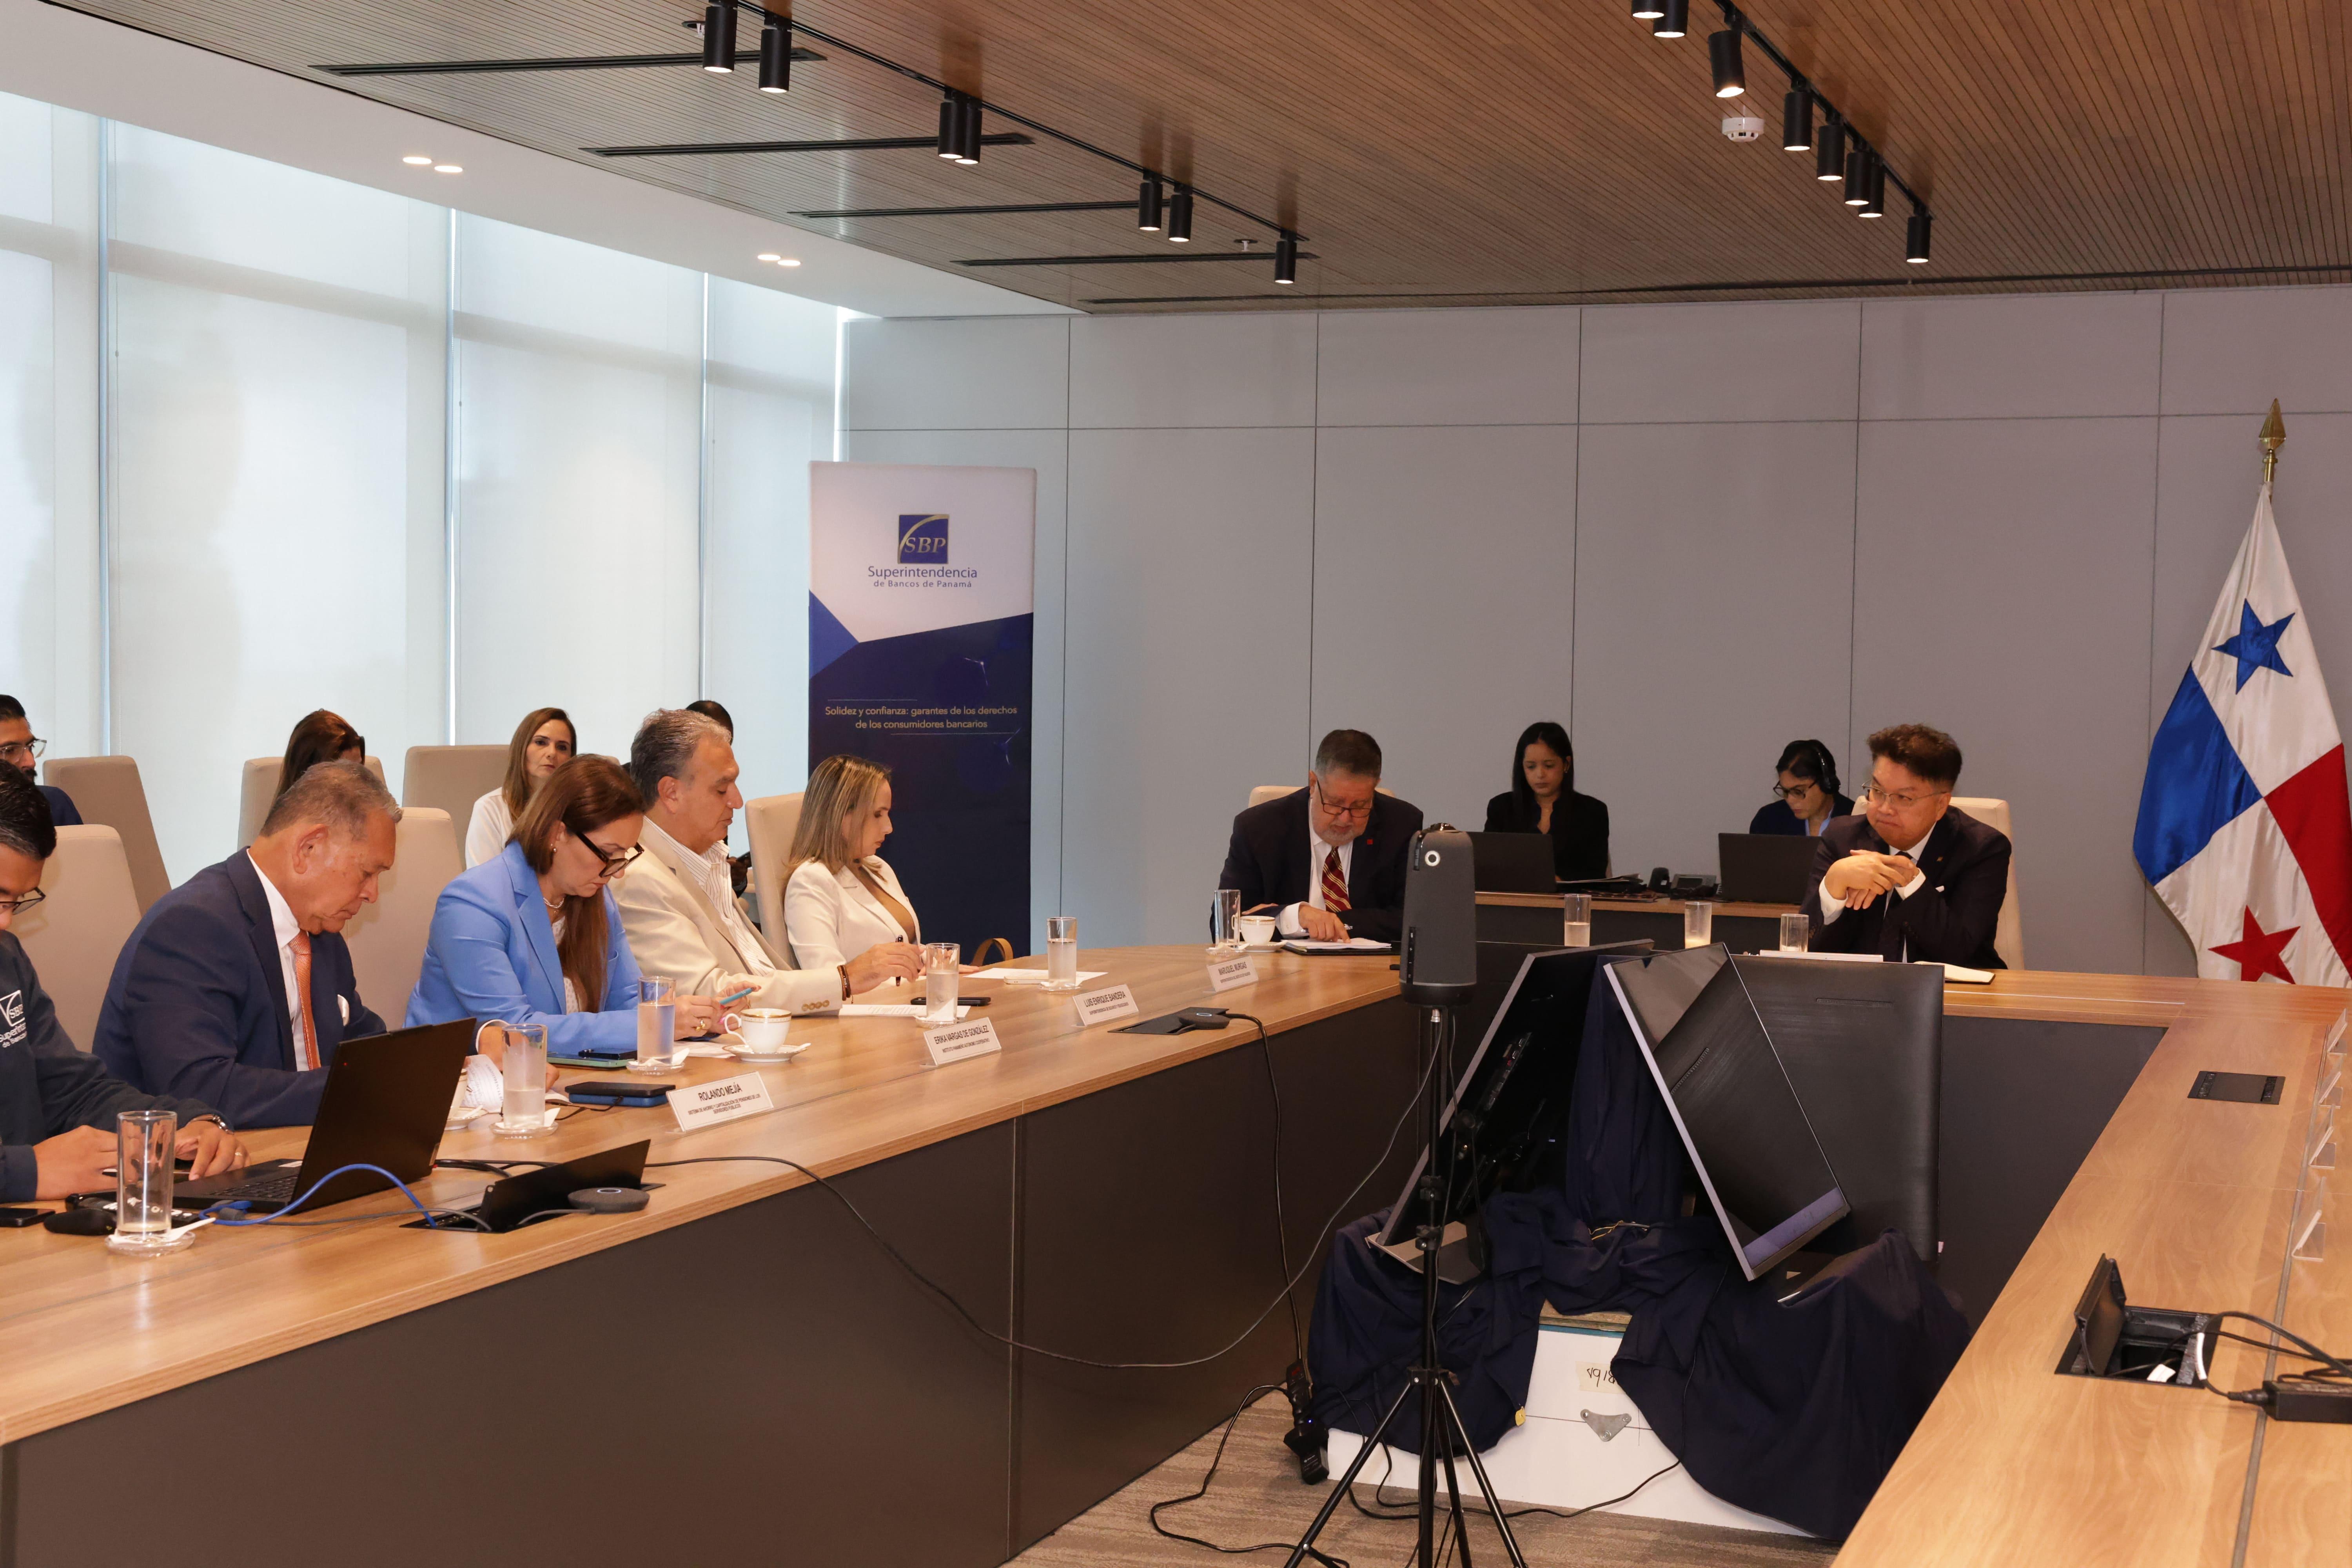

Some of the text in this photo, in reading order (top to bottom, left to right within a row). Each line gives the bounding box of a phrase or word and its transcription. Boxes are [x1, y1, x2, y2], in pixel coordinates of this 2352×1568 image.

[904, 537, 946, 553] SBP
[868, 566, 978, 580] Superintendencia
[888, 580, 919, 588] Bancos
[923, 580, 934, 588] de
[937, 580, 972, 588] Panamá
[825, 706, 1017, 718] Solidez y confianza: garantes de los derechos
[855, 719, 987, 729] de los consumidores bancarios
[1083, 991, 1127, 1007] LUIS ENRIQUE BANDERA
[934, 1024, 989, 1044] ERIKA VARGAS DE GONZÁLEZ
[698, 1082, 743, 1102] ROLANDO MEJÍA
